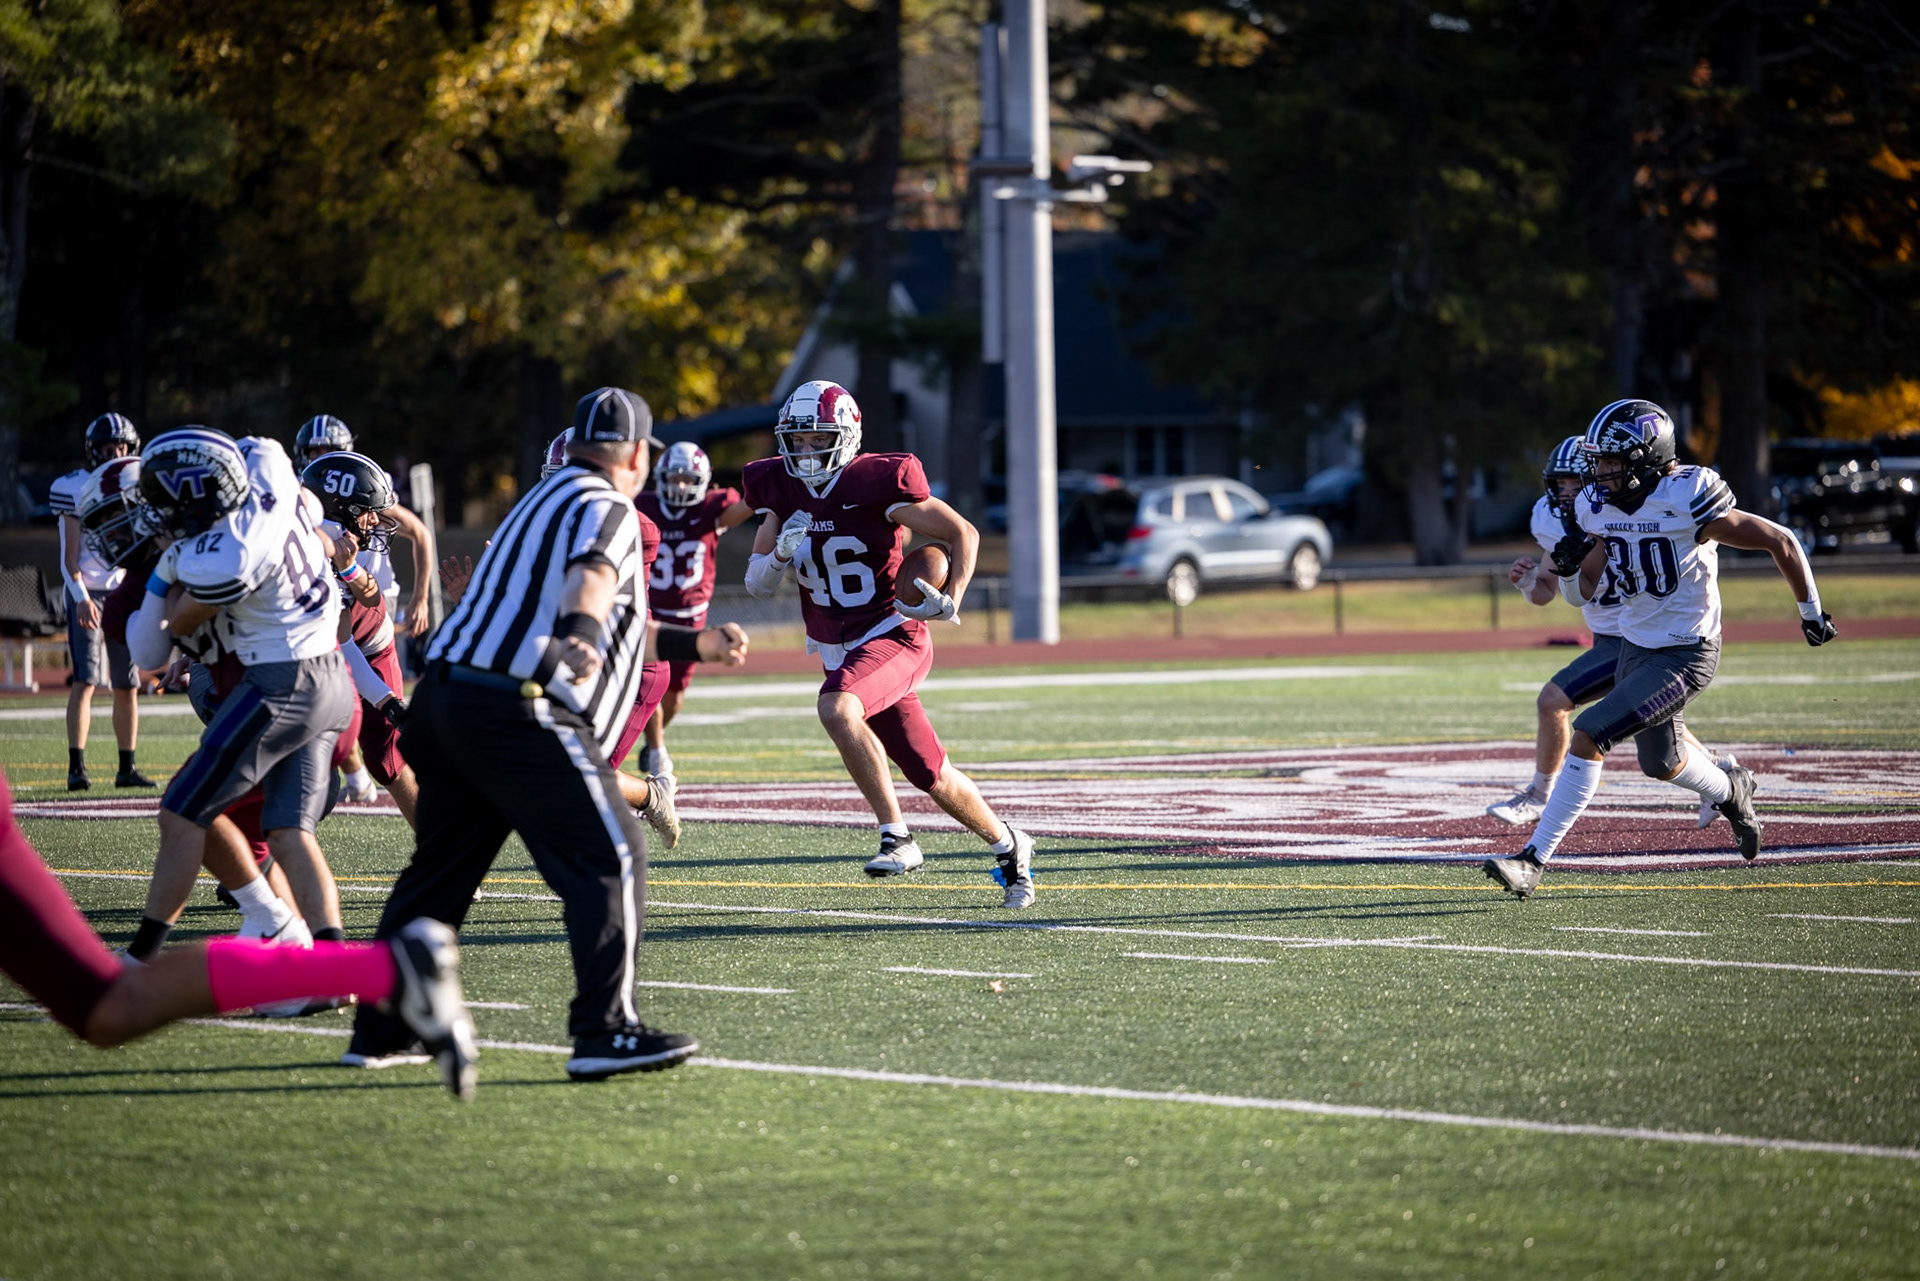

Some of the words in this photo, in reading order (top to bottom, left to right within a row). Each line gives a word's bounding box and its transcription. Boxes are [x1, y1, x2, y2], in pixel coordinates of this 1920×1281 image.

[1619, 412, 1661, 444] VT
[155, 466, 211, 500] VT
[323, 469, 356, 497] 50
[196, 533, 224, 555] 82
[1637, 522, 1661, 533] TECH
[649, 540, 707, 591] 33
[793, 536, 877, 608] 46
[1604, 535, 1681, 601] 30
